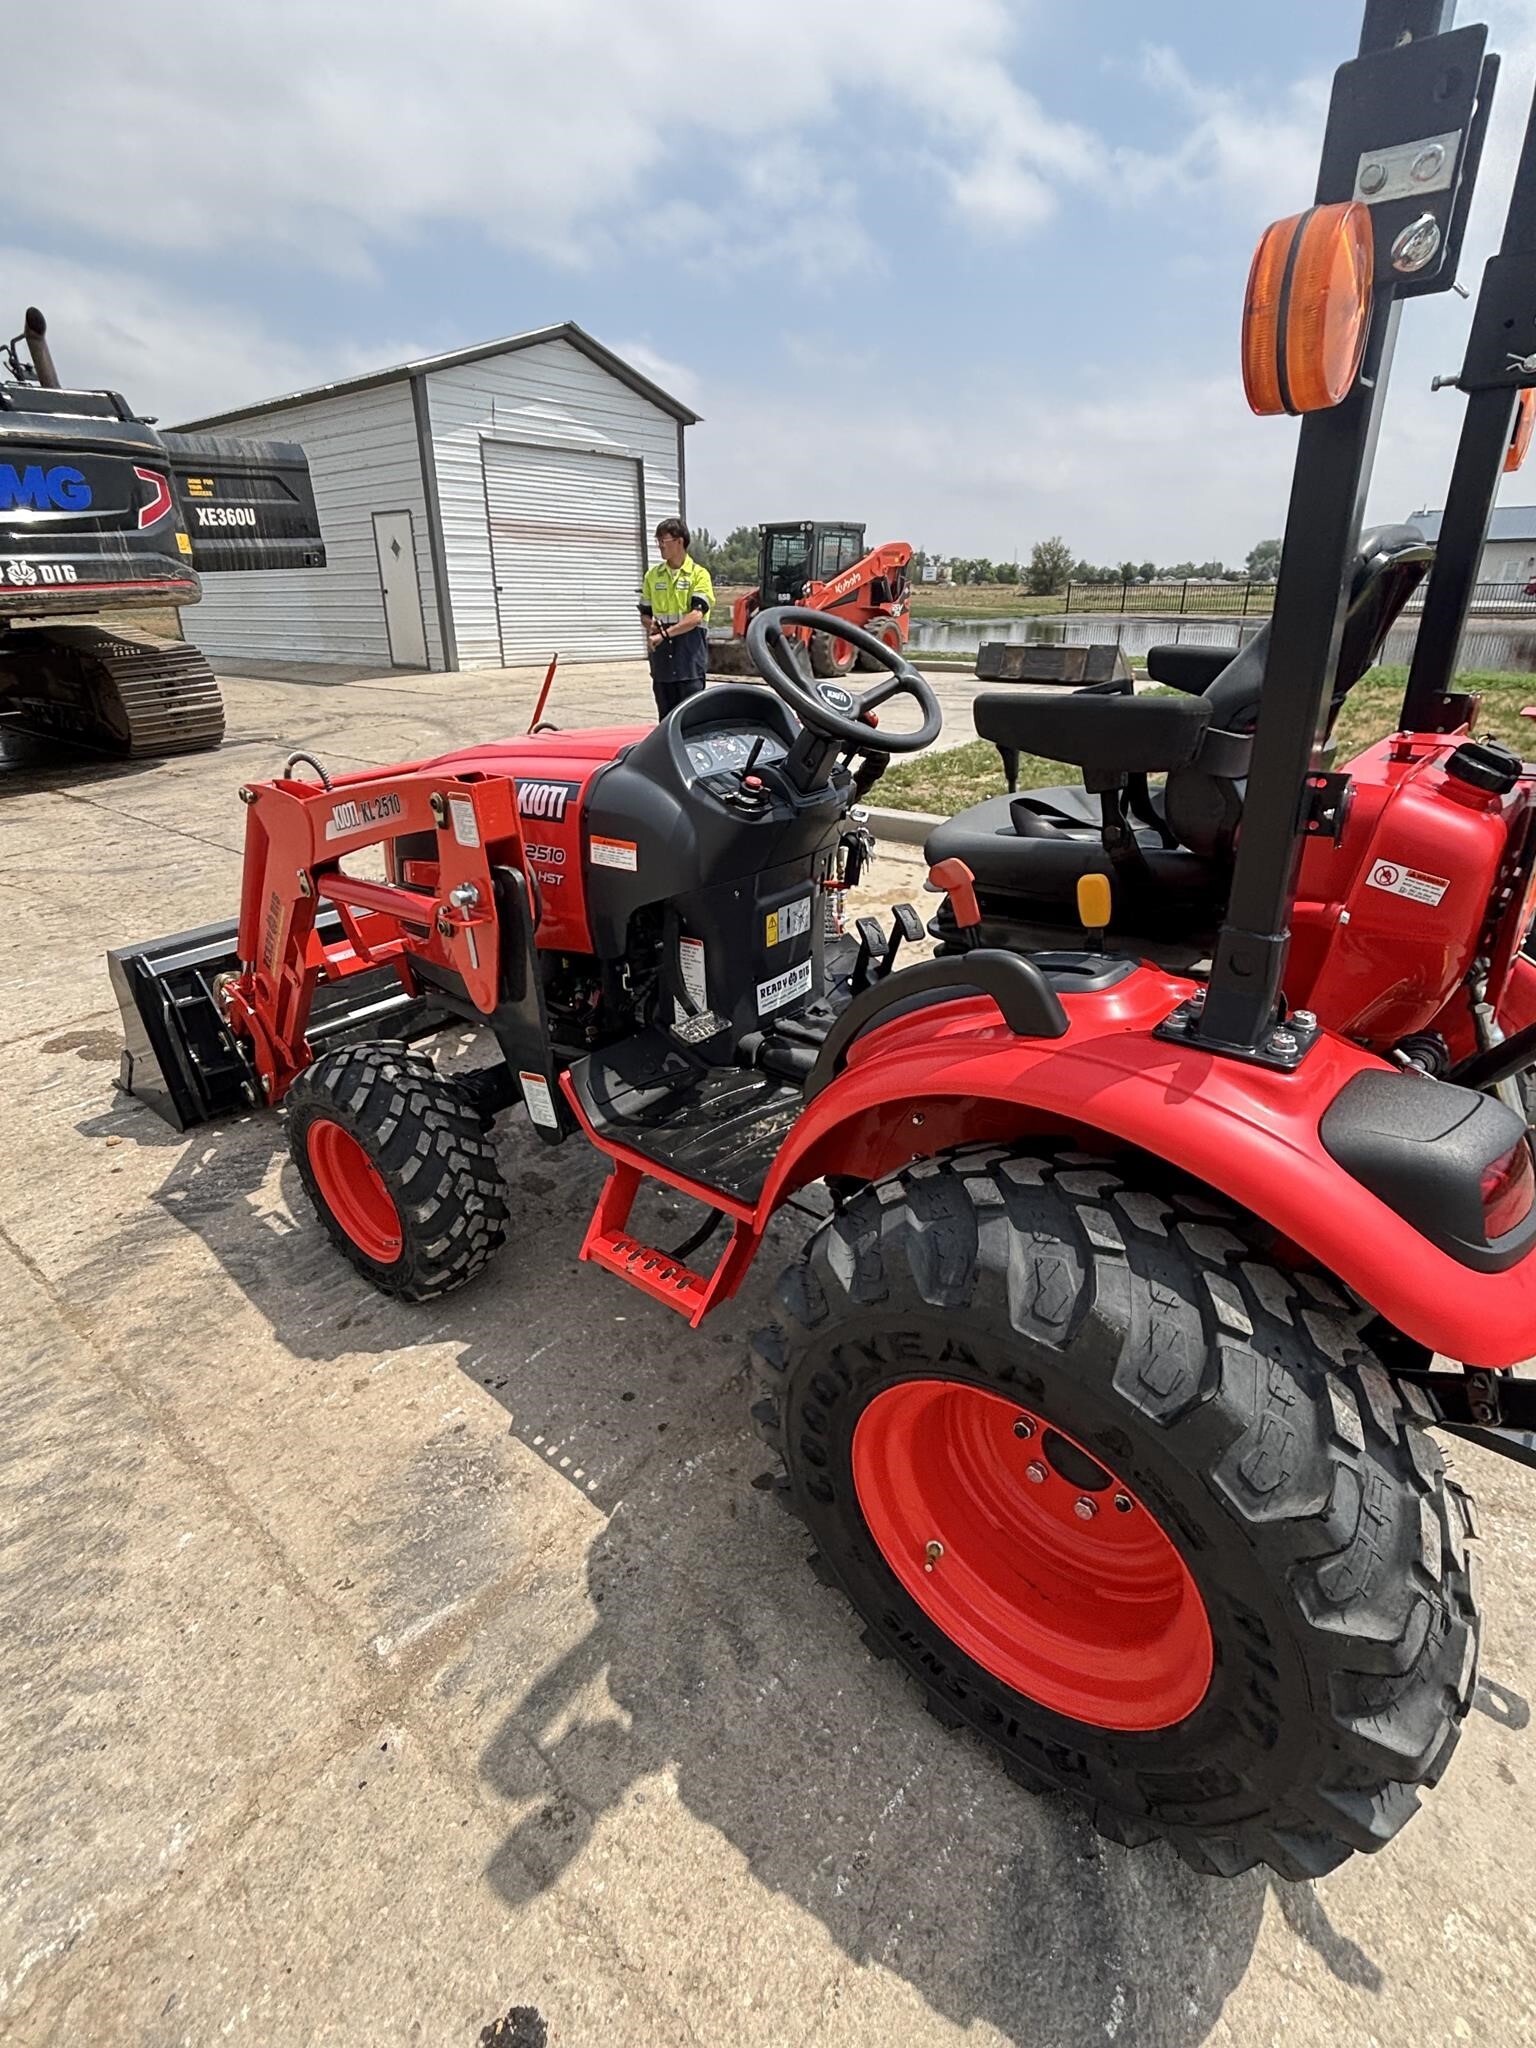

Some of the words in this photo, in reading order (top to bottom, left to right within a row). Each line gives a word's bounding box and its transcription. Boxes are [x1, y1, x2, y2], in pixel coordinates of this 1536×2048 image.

[195, 507, 256, 526] XE360U
[38, 564, 78, 584] DIG
[517, 783, 569, 819] KIOTI
[332, 801, 361, 831] KIOTI
[361, 801, 376, 823] KL
[377, 794, 401, 818] 2510
[525, 843, 566, 865] 2510
[538, 871, 564, 885] HST
[760, 978, 788, 999] READY
